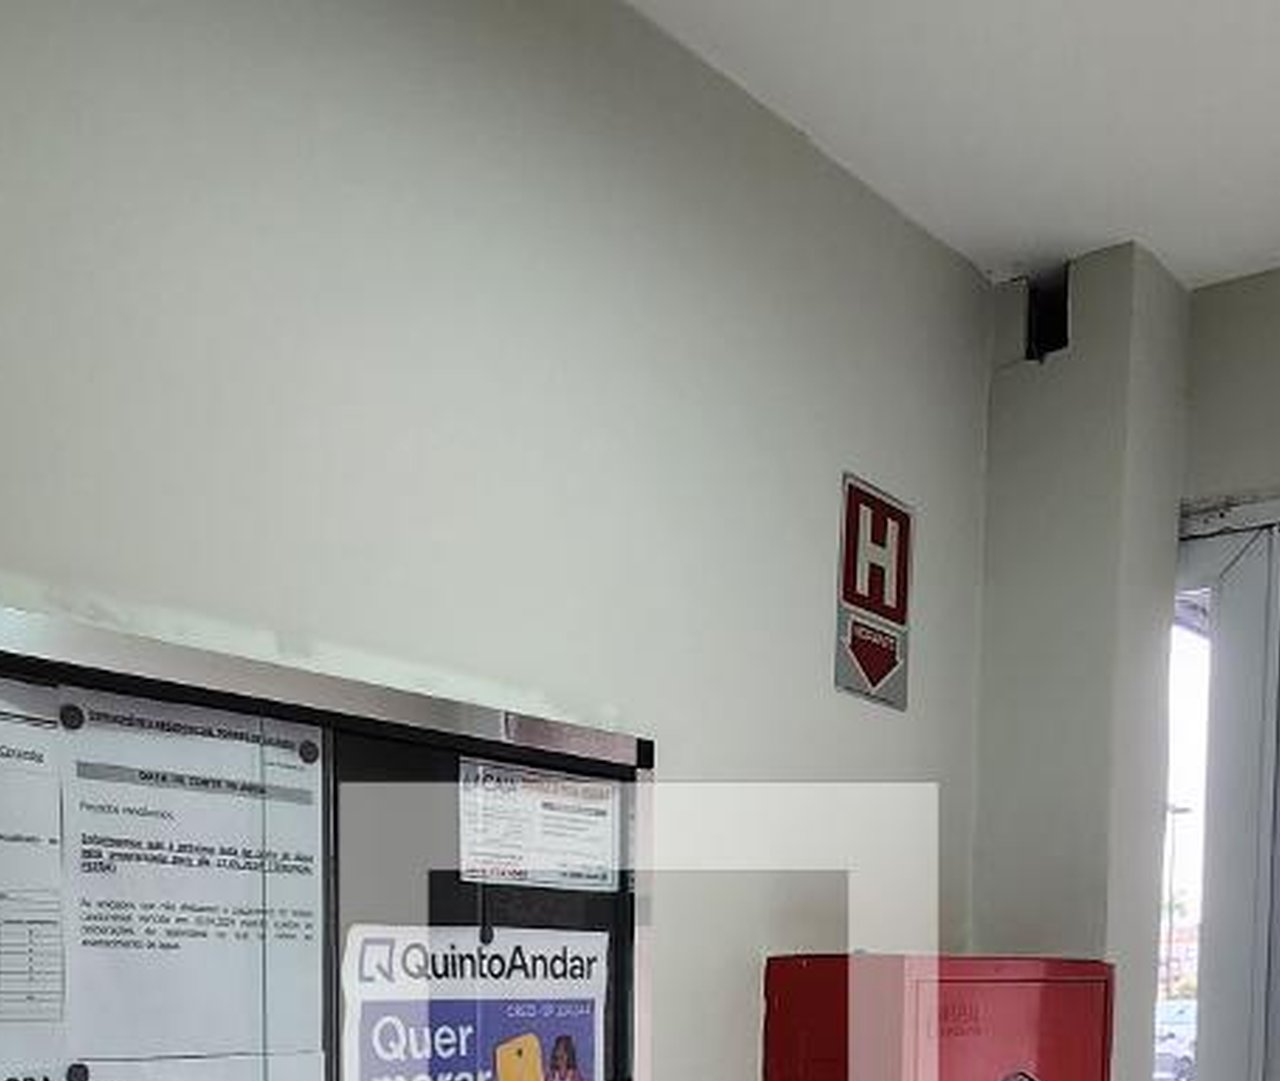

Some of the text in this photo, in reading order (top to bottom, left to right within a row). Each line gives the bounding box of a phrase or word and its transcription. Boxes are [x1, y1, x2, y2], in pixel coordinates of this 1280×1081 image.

[855, 502, 900, 609] H
[401, 943, 597, 980] QuintoAndar
[372, 1015, 474, 1062] Quer
